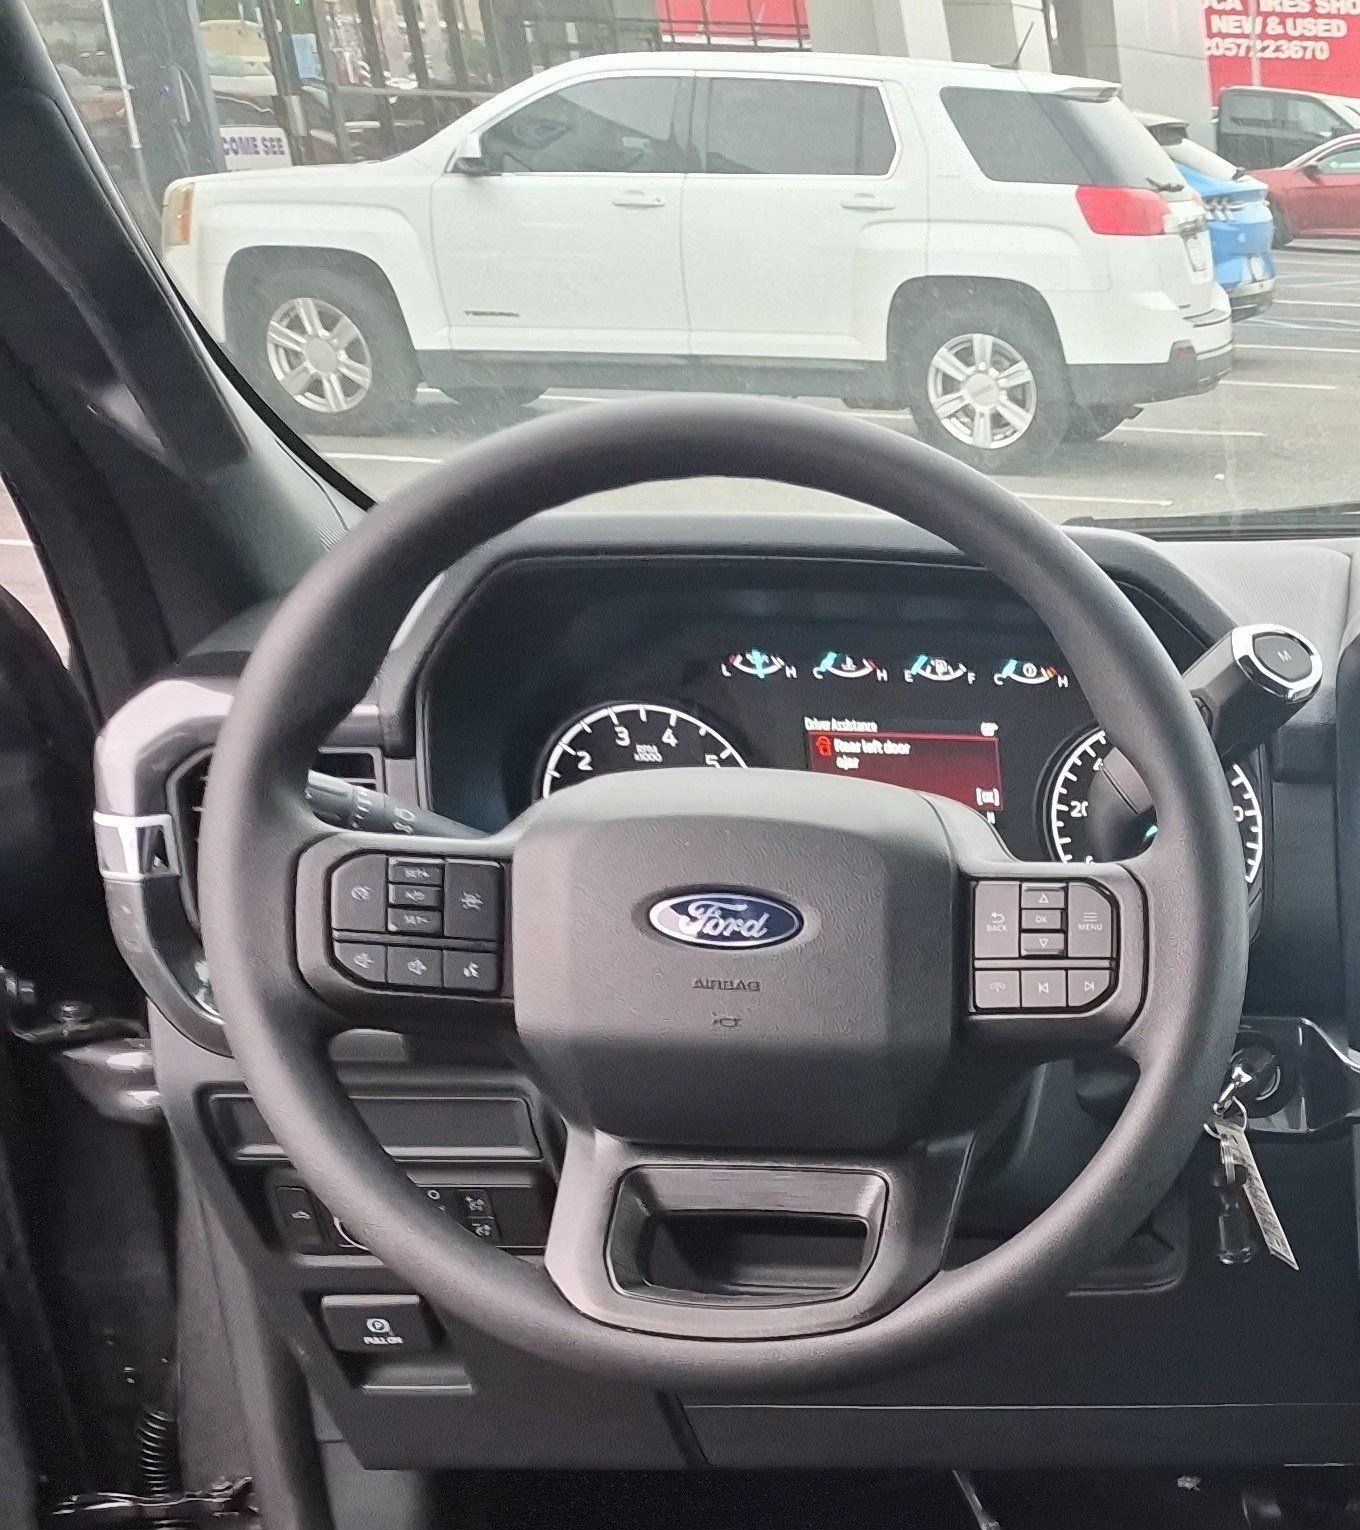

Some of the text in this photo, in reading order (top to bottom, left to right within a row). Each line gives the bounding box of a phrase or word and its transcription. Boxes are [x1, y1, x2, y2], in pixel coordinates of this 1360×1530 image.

[1210, 14, 1348, 38] NEW & USED
[261, 136, 286, 155] SEE
[721, 663, 732, 678] L
[785, 665, 798, 679] H
[812, 667, 824, 680] C
[877, 668, 888, 682] H
[905, 668, 914, 683] E
[967, 671, 977, 685] F
[993, 673, 1005, 686] C
[1058, 674, 1069, 688] H
[614, 726, 631, 747] 3
[662, 727, 679, 748] 4
[834, 738, 910, 754] Rear left door
[576, 750, 593, 771] 2
[679, 901, 770, 939] Ford
[1077, 921, 1103, 932] MENU
[986, 923, 1008, 933] BACK
